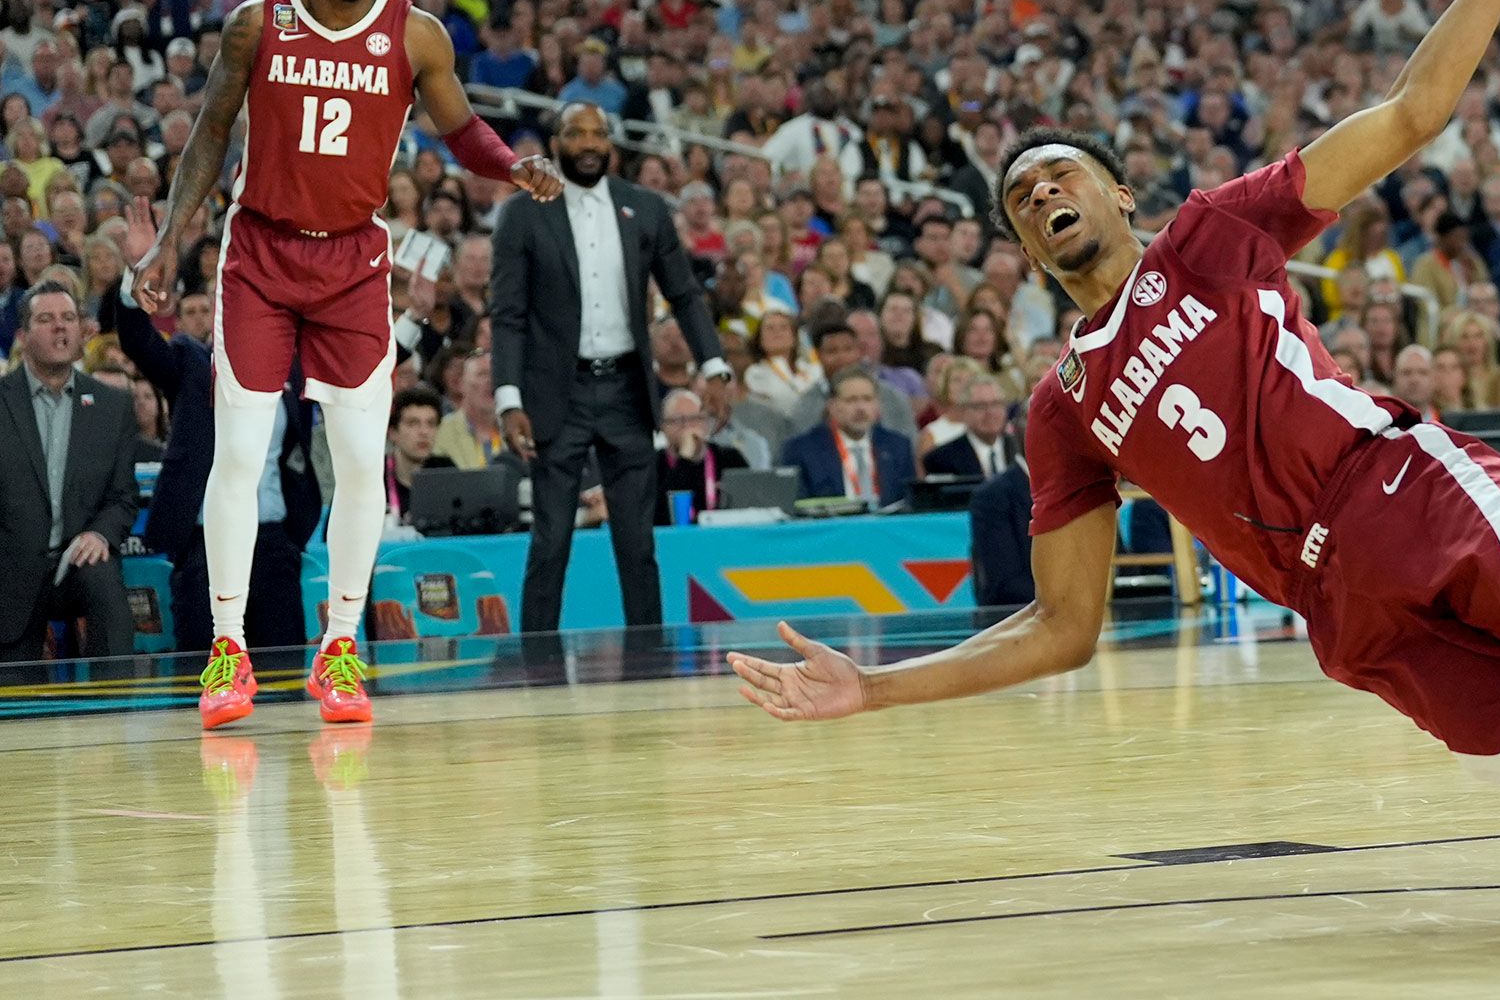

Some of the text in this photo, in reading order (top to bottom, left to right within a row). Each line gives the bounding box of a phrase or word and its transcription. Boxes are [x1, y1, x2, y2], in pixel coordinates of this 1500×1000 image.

[368, 36, 389, 51] SEC
[268, 55, 389, 95] ALABAMA
[299, 96, 352, 156] 12
[1135, 274, 1164, 304] SEC
[1090, 294, 1218, 457] ALABAMA
[1157, 383, 1227, 462] 3
[1300, 522, 1329, 568] RTR
